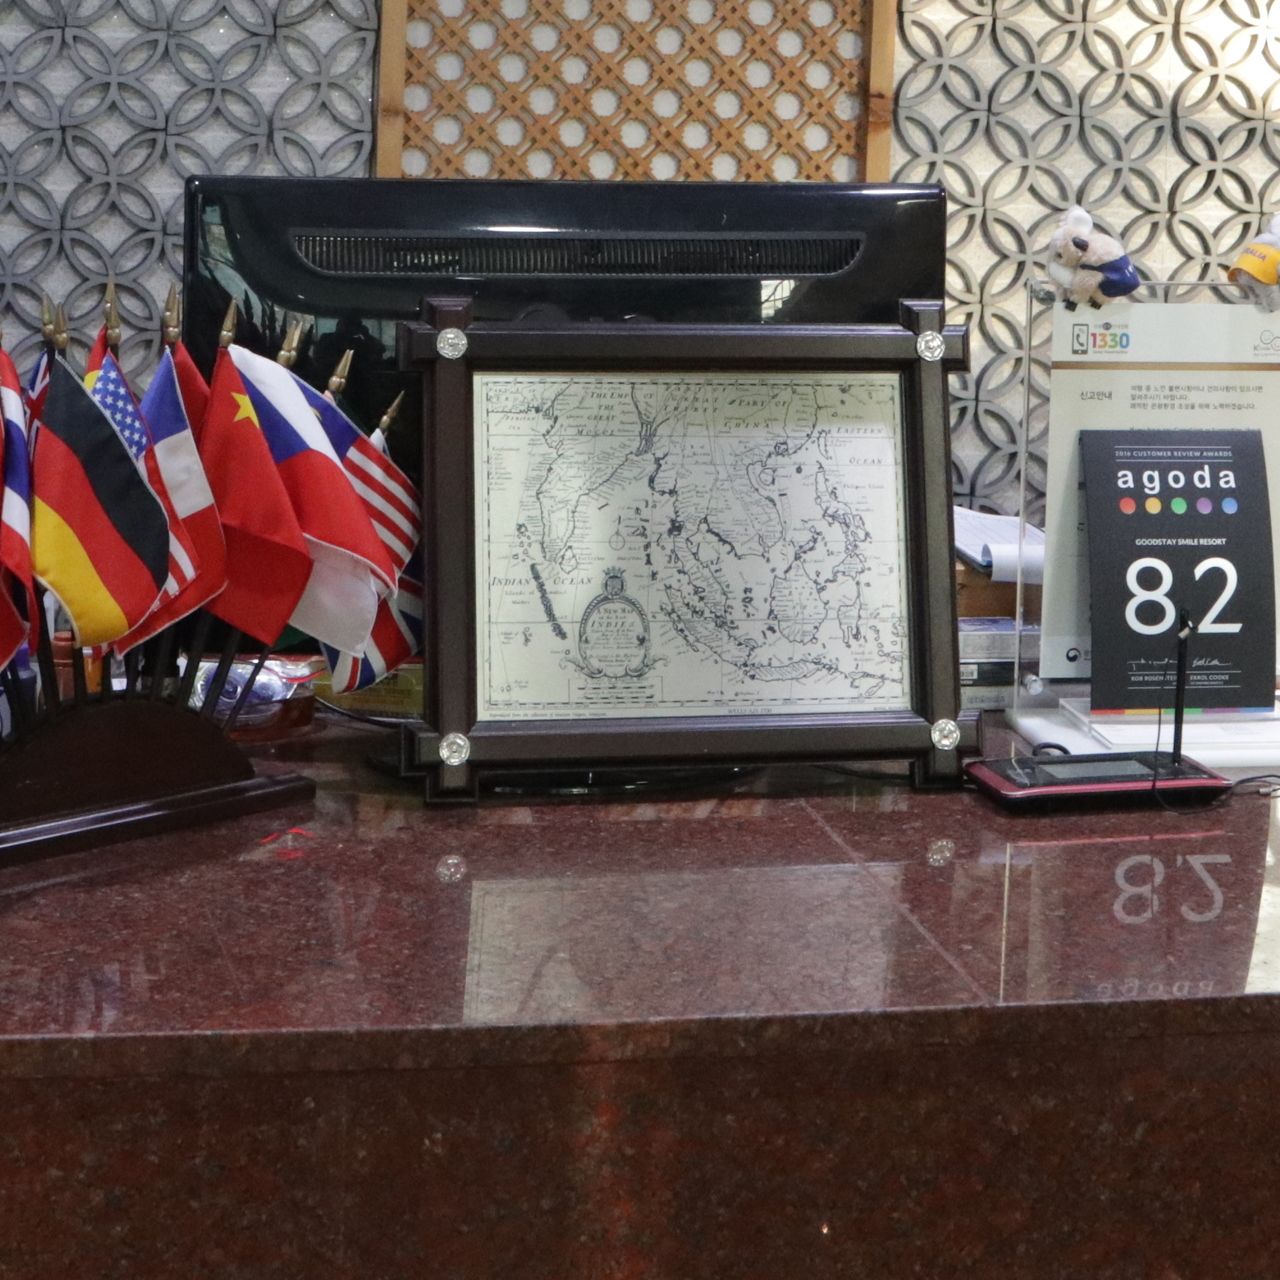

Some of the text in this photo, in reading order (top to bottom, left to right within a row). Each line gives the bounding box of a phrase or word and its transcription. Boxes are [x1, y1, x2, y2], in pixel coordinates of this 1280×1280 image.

[1090, 332, 1131, 349] 1330
[1080, 391, 1113, 401] 신고안내
[1117, 464, 1236, 495] agoda
[1135, 538, 1227, 546] GOODSTAY SMILE RESORT
[1124, 557, 1243, 635] 82
